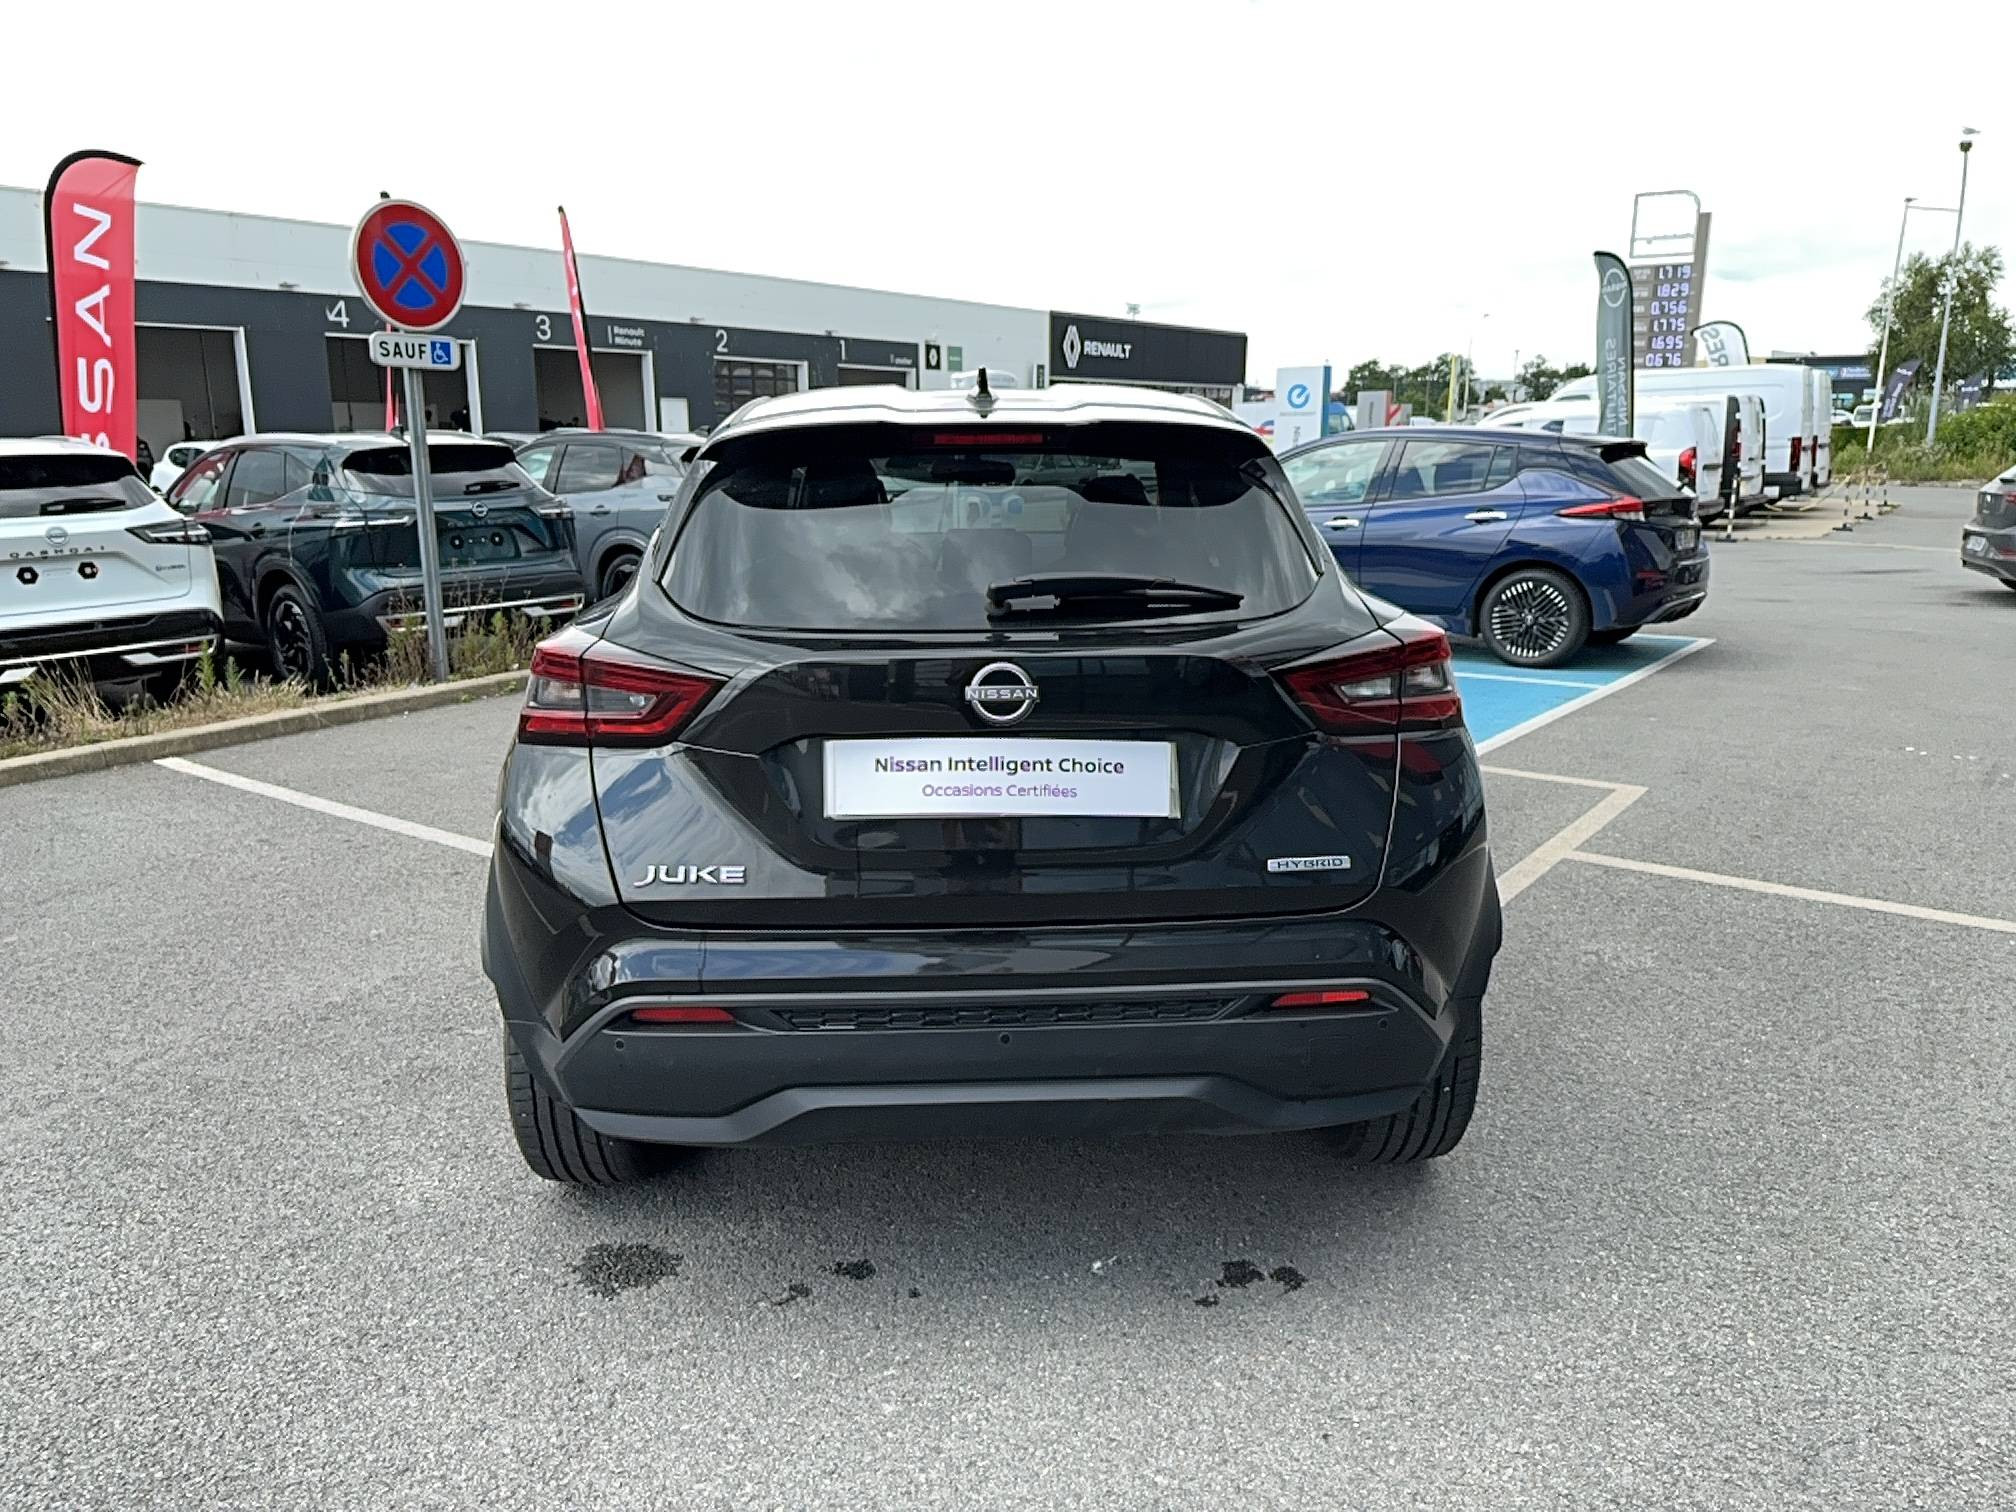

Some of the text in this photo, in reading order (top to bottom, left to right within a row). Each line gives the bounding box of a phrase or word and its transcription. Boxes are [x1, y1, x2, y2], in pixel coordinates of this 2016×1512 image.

[325, 300, 350, 328] 4
[535, 314, 552, 341] 3
[379, 341, 427, 360] SAUF
[715, 329, 729, 353] 2
[1083, 340, 1132, 359] RENAULT
[966, 688, 1038, 699] NISSAN
[875, 756, 1125, 776] Nissan Intelligent Choice
[922, 783, 1078, 798] Occasions Certifiées
[1277, 857, 1344, 869] HYBRID
[633, 865, 746, 888] JUKE
